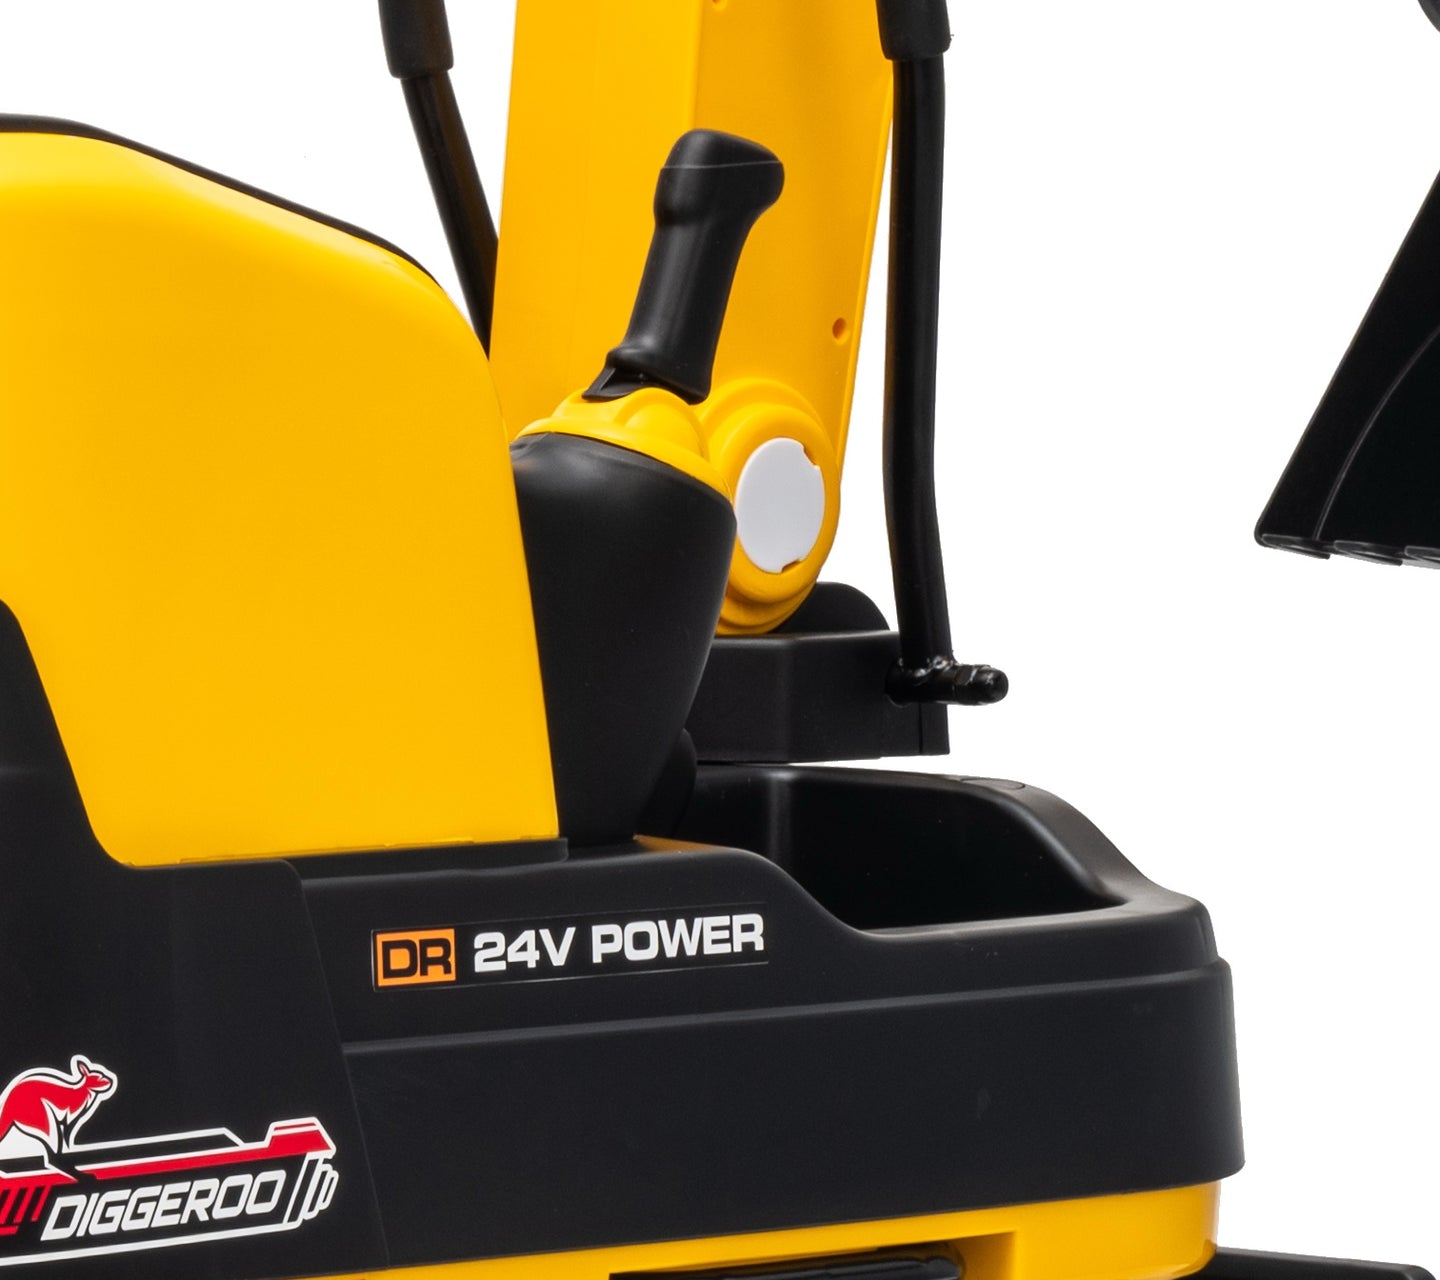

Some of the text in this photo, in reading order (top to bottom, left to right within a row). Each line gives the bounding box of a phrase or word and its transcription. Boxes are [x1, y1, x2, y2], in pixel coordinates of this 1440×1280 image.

[381, 913, 765, 979] DR 24V POWER
[39, 1169, 287, 1242] DIGGEROO
